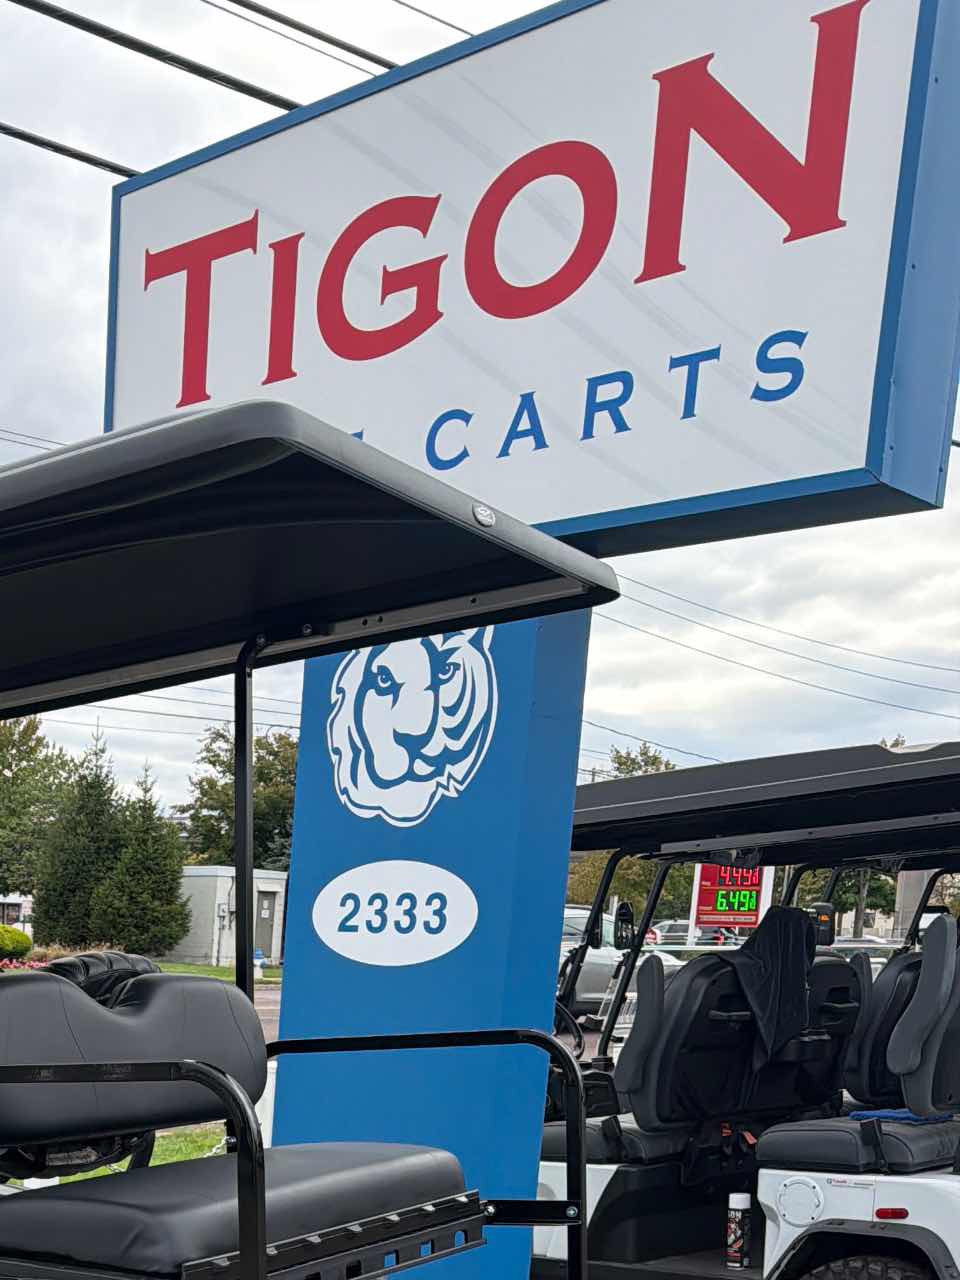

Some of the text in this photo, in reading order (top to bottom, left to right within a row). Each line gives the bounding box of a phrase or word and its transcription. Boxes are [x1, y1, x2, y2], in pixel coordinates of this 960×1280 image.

[144, 0, 868, 406] TIGON
[426, 330, 808, 470] CARTS
[337, 892, 447, 935] 2333
